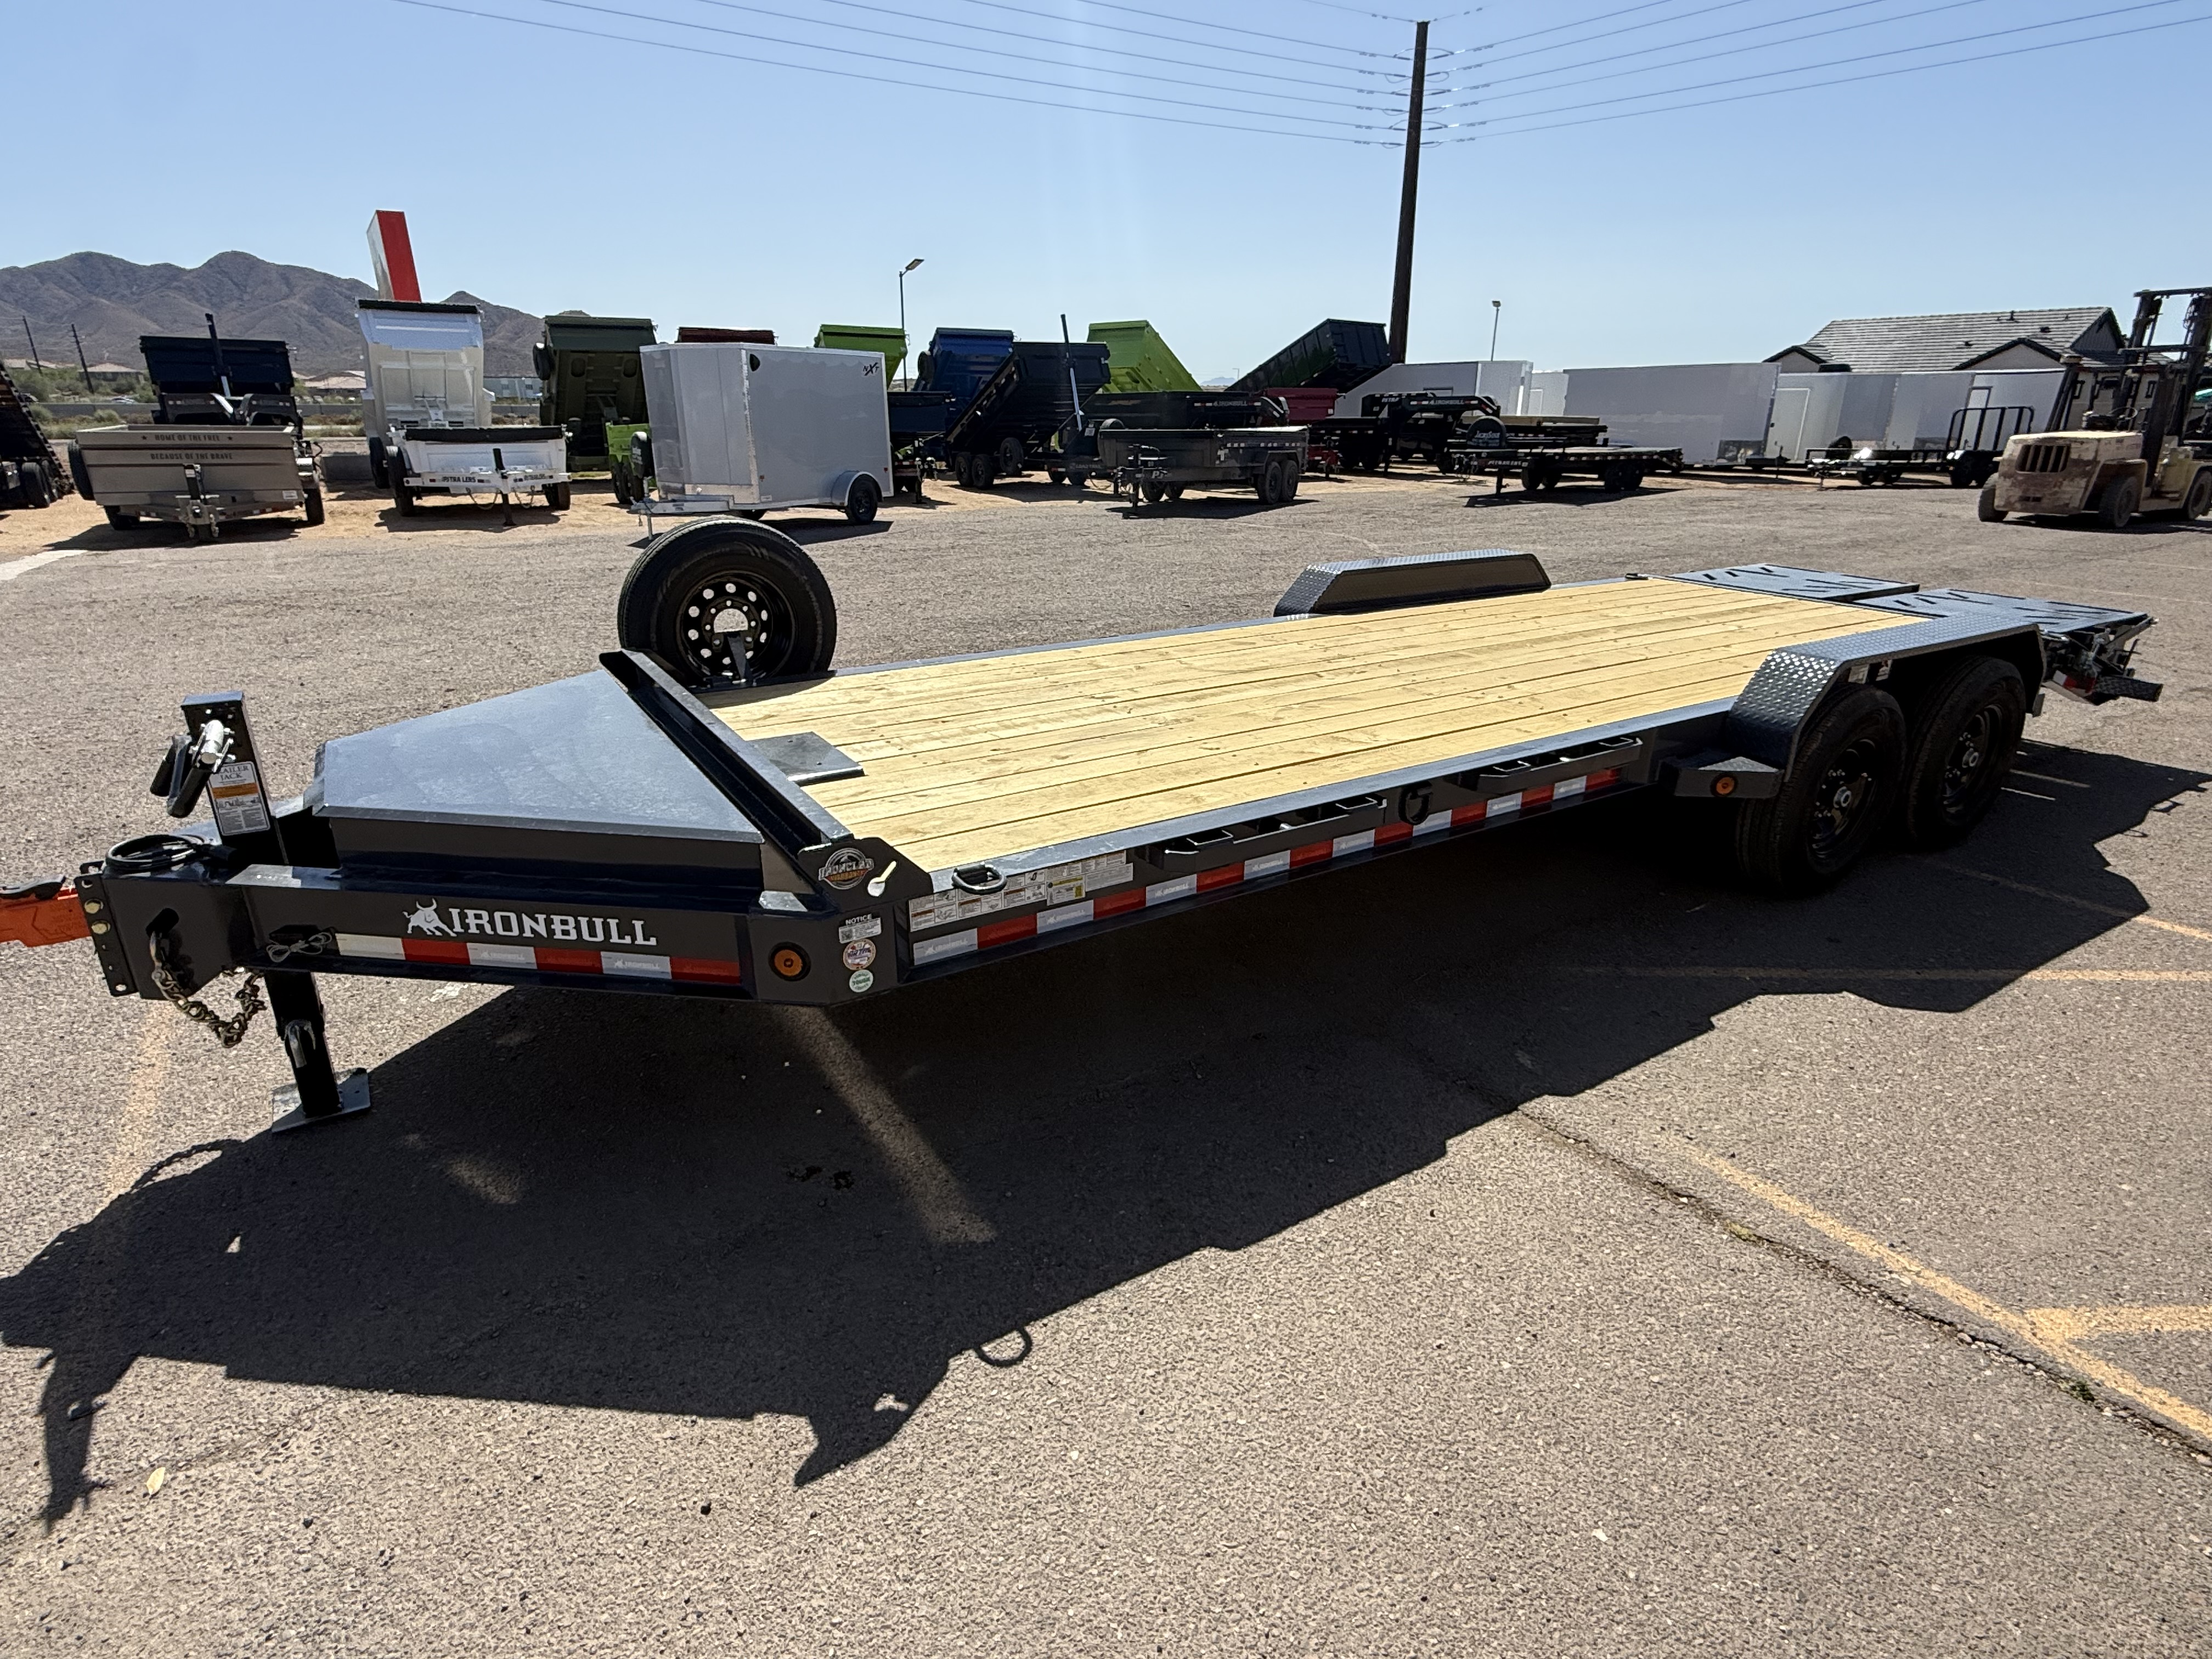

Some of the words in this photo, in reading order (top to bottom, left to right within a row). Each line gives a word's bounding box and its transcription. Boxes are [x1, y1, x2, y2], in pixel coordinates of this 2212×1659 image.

[863, 362, 879, 376] NXT
[221, 765, 249, 774] AILER
[221, 772, 242, 781] JACK
[845, 913, 872, 926] NOTICE
[449, 908, 657, 946] IRONBULL
